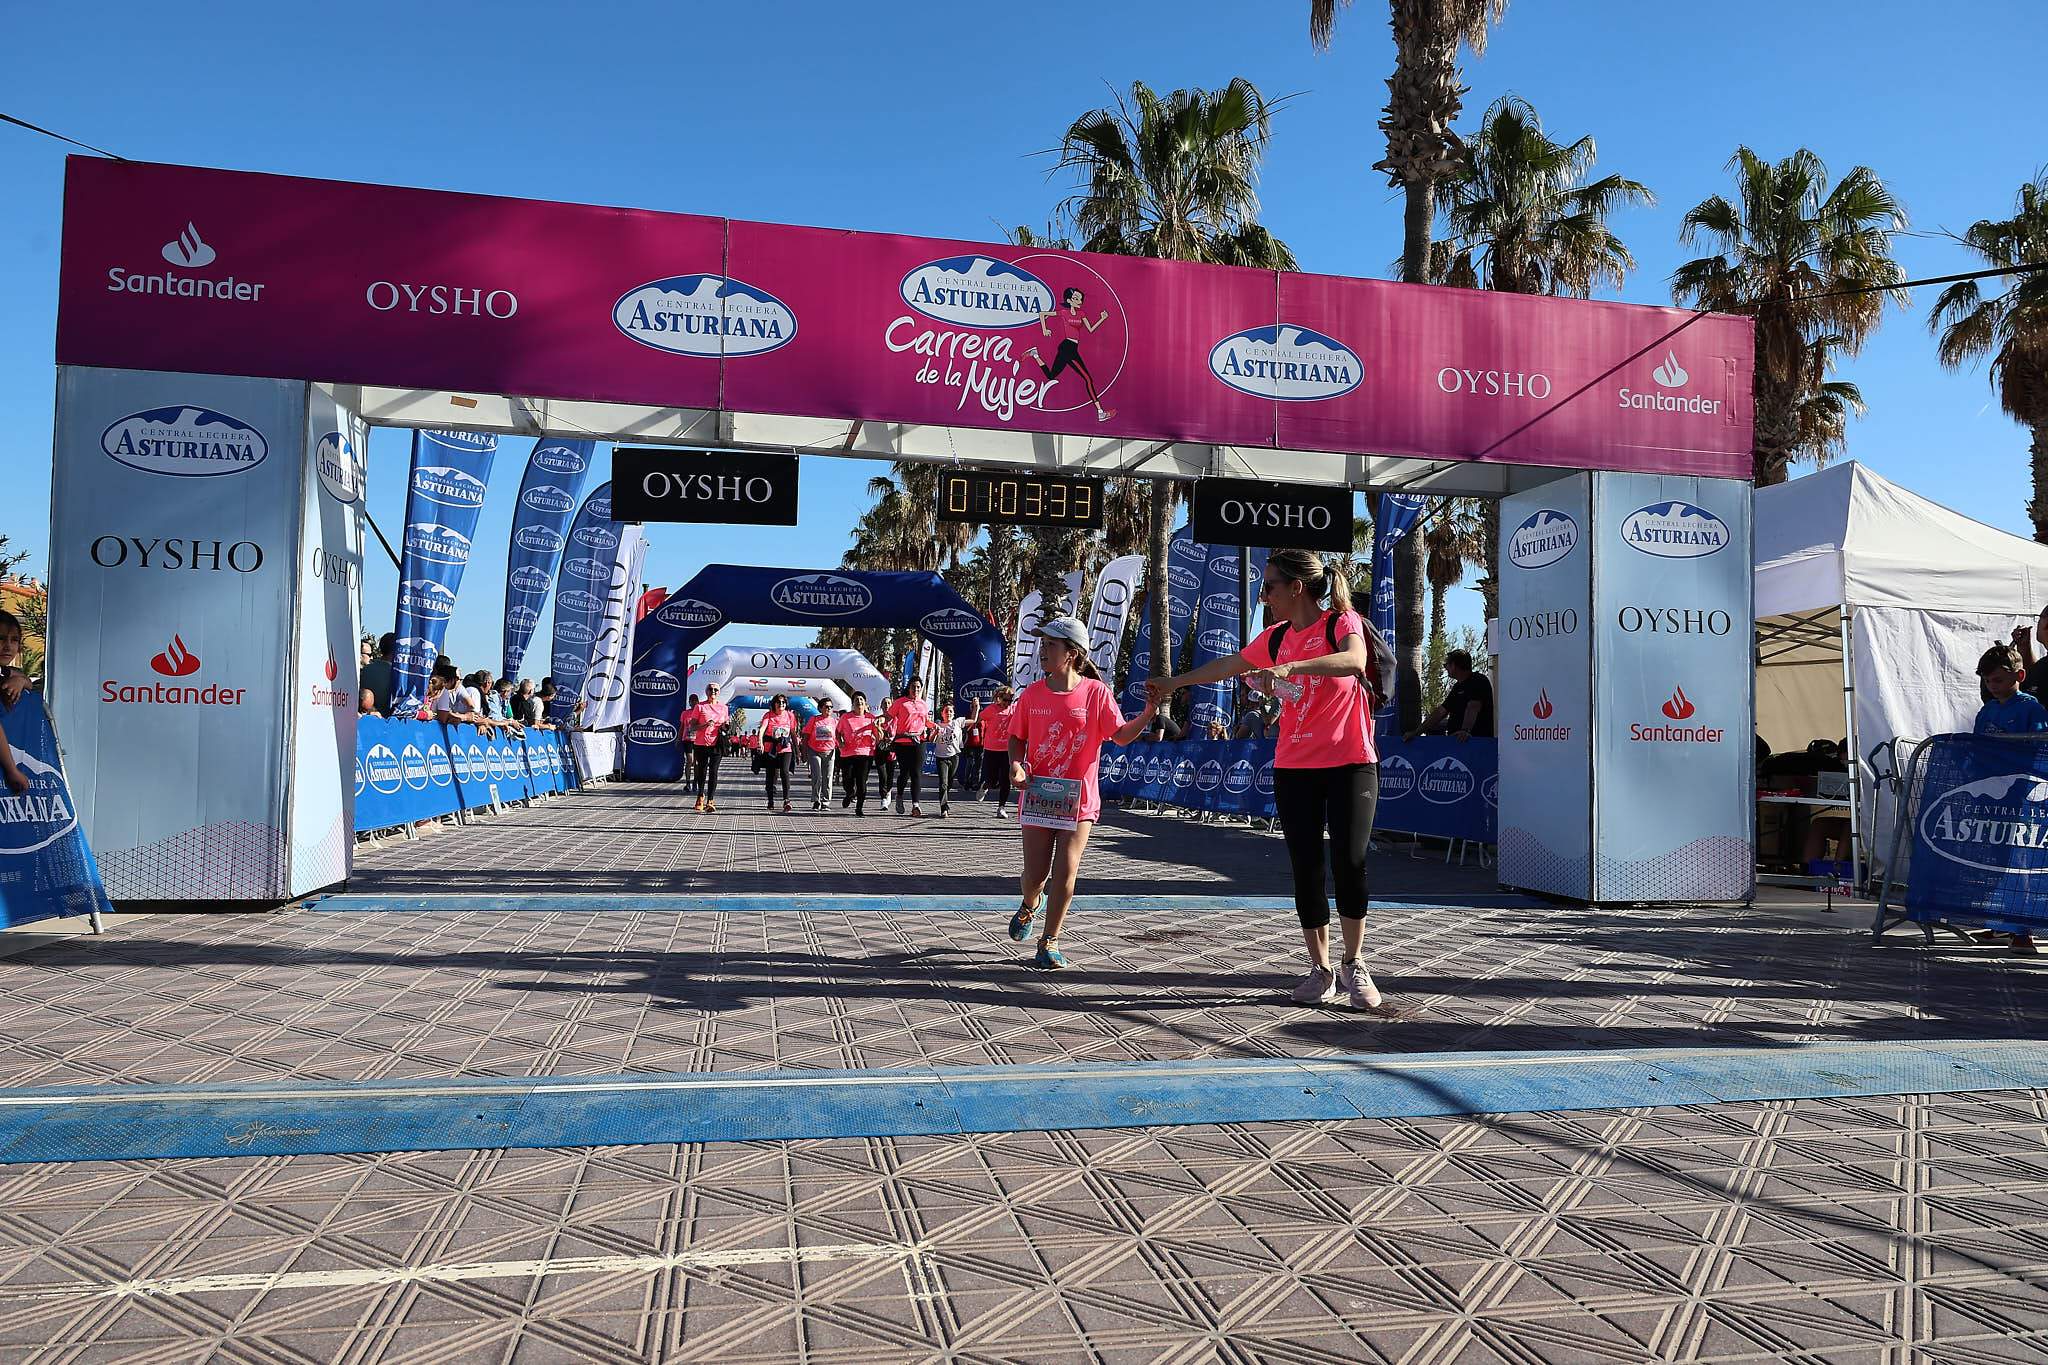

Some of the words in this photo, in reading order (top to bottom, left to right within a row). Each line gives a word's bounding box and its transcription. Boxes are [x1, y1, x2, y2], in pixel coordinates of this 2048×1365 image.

[107, 267, 264, 301] Santander
[912, 277, 1042, 313] ASTURIANA
[936, 276, 986, 287] CENTRAL
[990, 282, 1039, 292] LECHERA
[366, 281, 519, 320] OYSHO
[656, 299, 714, 311] CENTRAL
[627, 300, 783, 339] ASTURIANA
[885, 316, 1013, 362] Carrera
[1223, 350, 1351, 384] ASTURIANA
[1245, 347, 1291, 358] CENTRAL
[1297, 352, 1348, 363] LECHERA
[915, 358, 940, 383] de
[945, 359, 962, 386] la
[957, 360, 1059, 421] Mujer
[1437, 367, 1551, 400] OYSHO
[1619, 388, 1721, 415] Santander
[114, 429, 255, 462] ASTURIANA
[140, 427, 193, 439] CENTRAL
[199, 431, 251, 441] LECHERA
[643, 472, 773, 503] OYSHO
[950, 478, 1091, 518] 01:03:33
[1220, 500, 1331, 530] OYSHO
[1645, 519, 1679, 528] CENTRAL
[1682, 521, 1718, 529] LECHERA
[1512, 531, 1573, 559] ASTURIANA
[1629, 520, 1722, 546] ASTURIANA
[91, 536, 264, 573] OYSHO
[313, 548, 358, 590] OYSHO
[779, 585, 865, 606] ASTURIANA
[661, 609, 716, 622] ASTURIANA
[925, 617, 979, 630] ASTURIANA
[1508, 608, 1578, 641] OYSHO
[1618, 606, 1731, 636] OYSHO
[750, 652, 831, 672] OYSHO
[102, 680, 246, 705] Santander
[311, 685, 349, 708] Santander
[633, 679, 677, 691] ASTURIANA
[963, 687, 993, 698] ASTURI
[630, 725, 674, 739] ASTURIANA
[1514, 724, 1571, 741] Santander
[1630, 723, 1724, 743] Santander
[1380, 777, 1410, 788] TURIANA
[1421, 773, 1467, 793] ASTURIANA
[1964, 805, 2025, 817] CENTRAL
